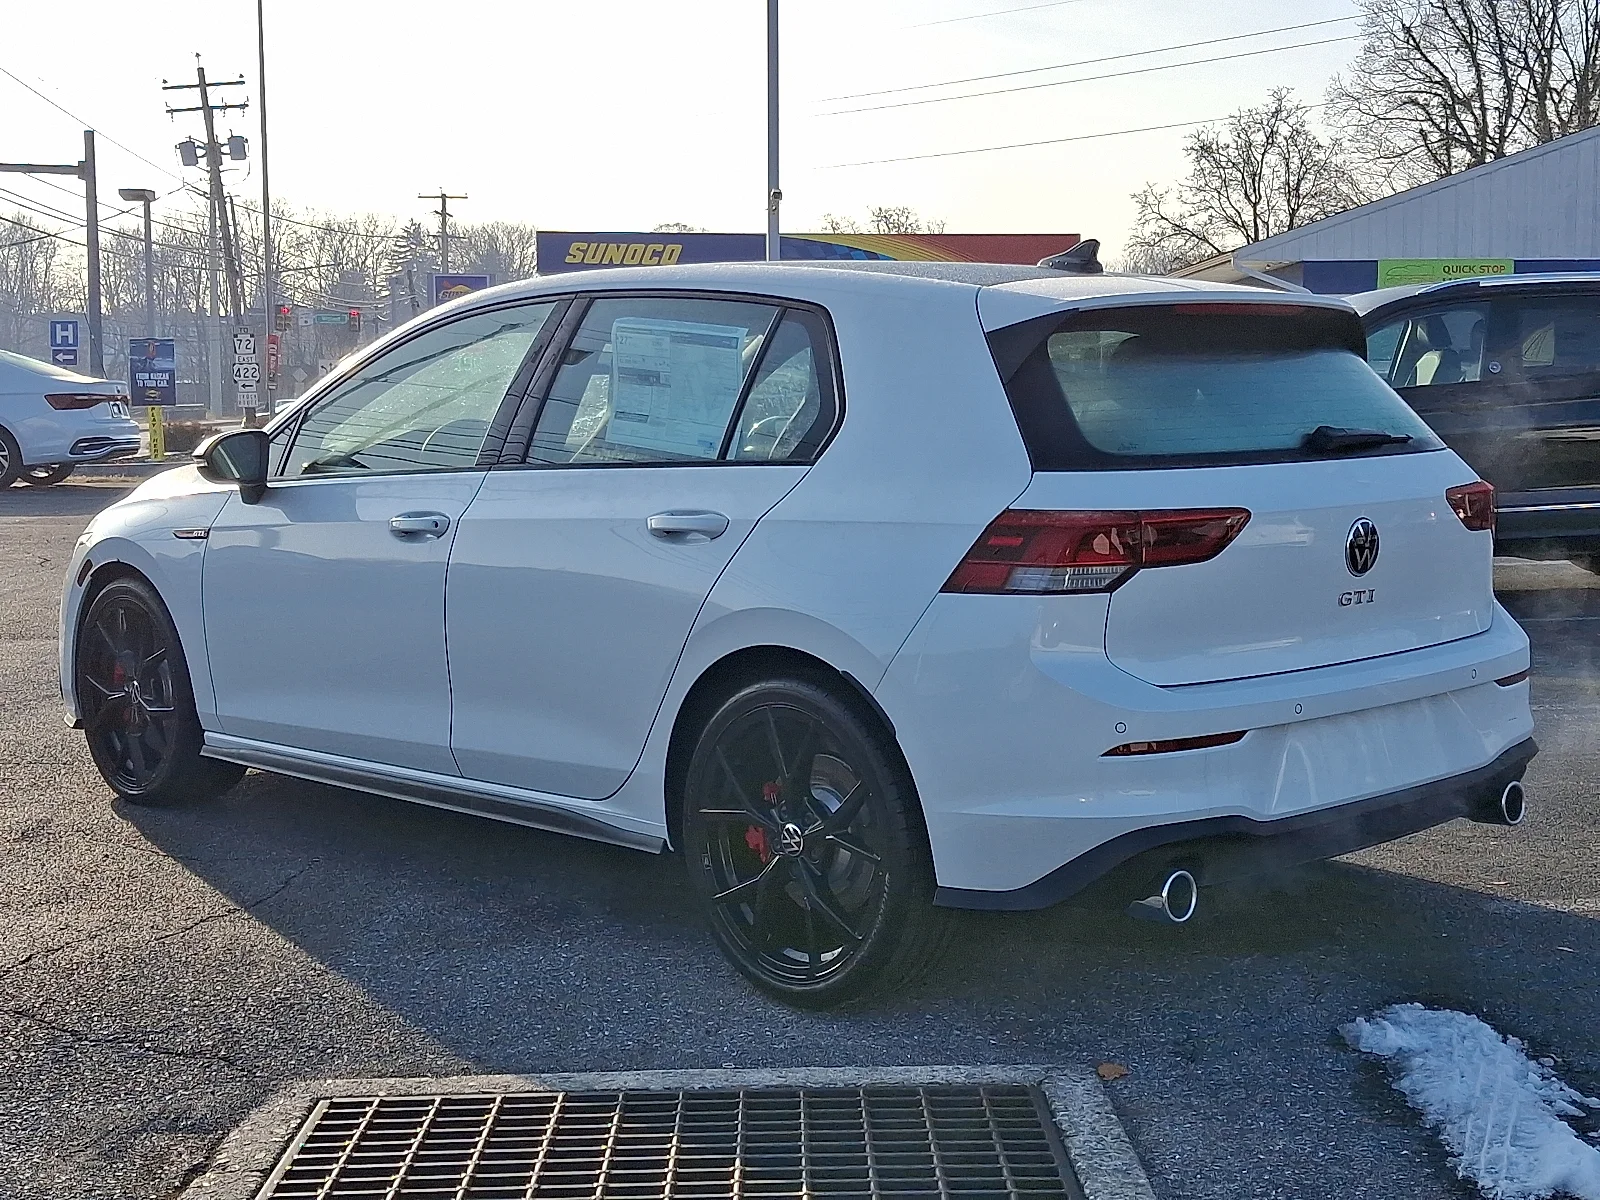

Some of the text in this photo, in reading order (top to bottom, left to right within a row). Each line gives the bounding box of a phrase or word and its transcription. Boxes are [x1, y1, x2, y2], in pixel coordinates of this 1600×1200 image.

[564, 242, 683, 265] SUNOCO
[1442, 264, 1506, 274] QUICK STOP
[55, 323, 74, 345] H
[236, 338, 252, 350] 72
[237, 355, 254, 363] EAST
[234, 367, 258, 379] 422
[1338, 588, 1376, 607] GTI
